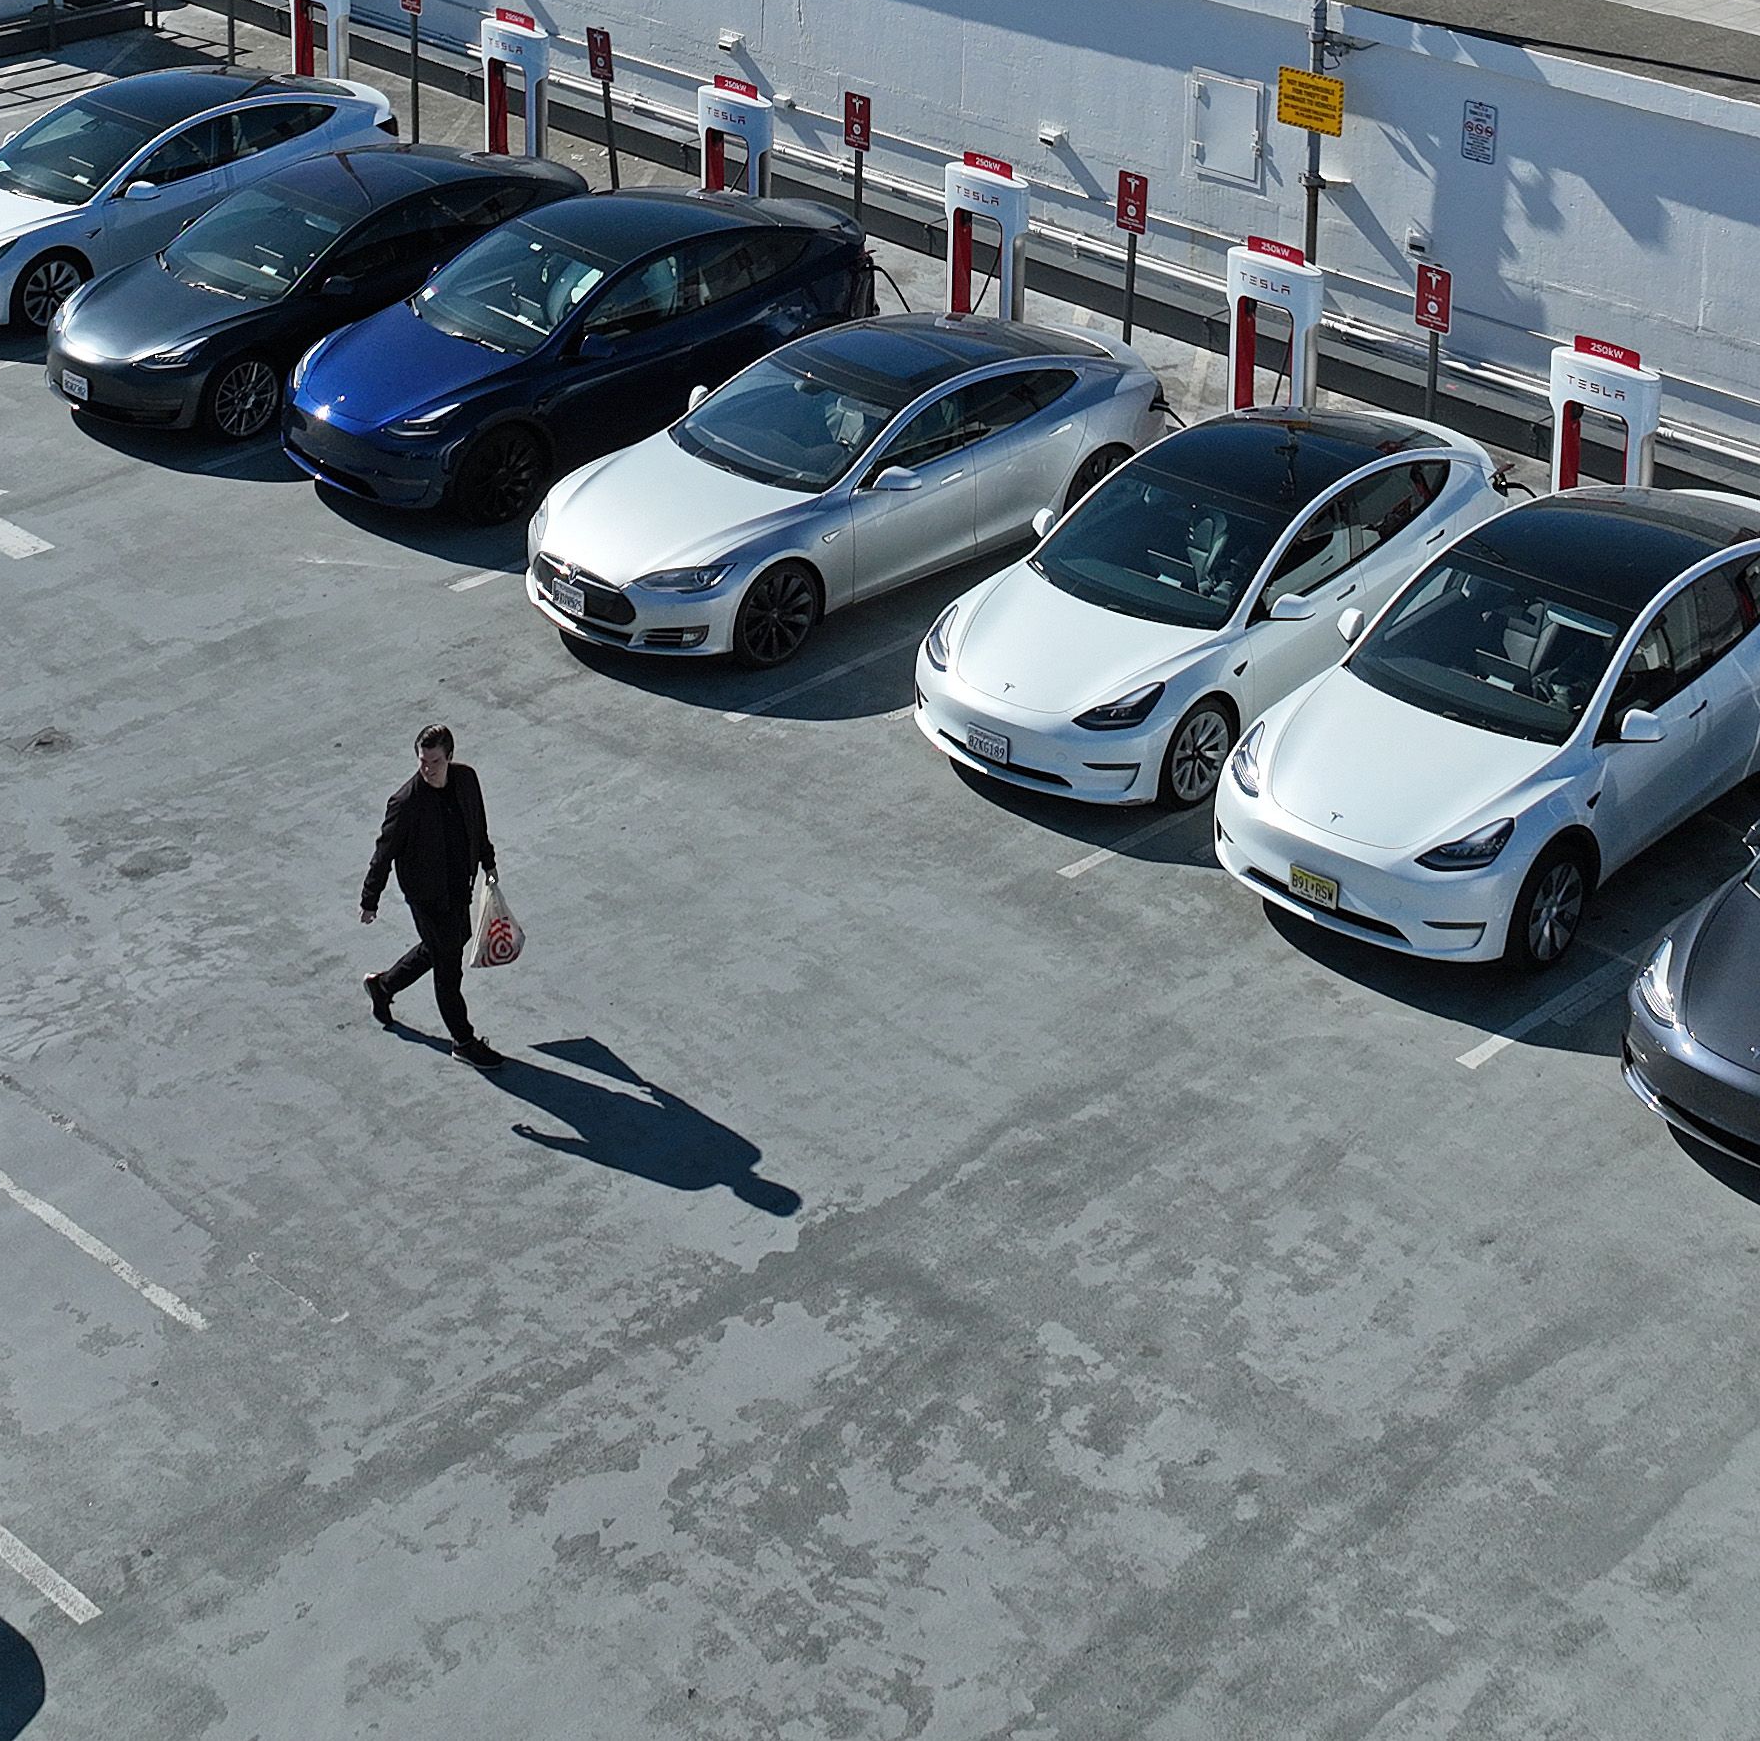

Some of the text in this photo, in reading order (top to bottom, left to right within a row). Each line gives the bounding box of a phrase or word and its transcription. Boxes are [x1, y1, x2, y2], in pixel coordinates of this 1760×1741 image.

[487, 37, 524, 56] TESLA
[723, 79, 748, 92] 250kW
[706, 106, 747, 126] TESLA
[975, 157, 1002, 172] 250kW
[955, 184, 1000, 207] TESLA
[1261, 241, 1291, 258] 250kW
[1240, 271, 1292, 296] TESLA
[1590, 342, 1625, 360] 250kW
[1567, 374, 1626, 402] TESLA
